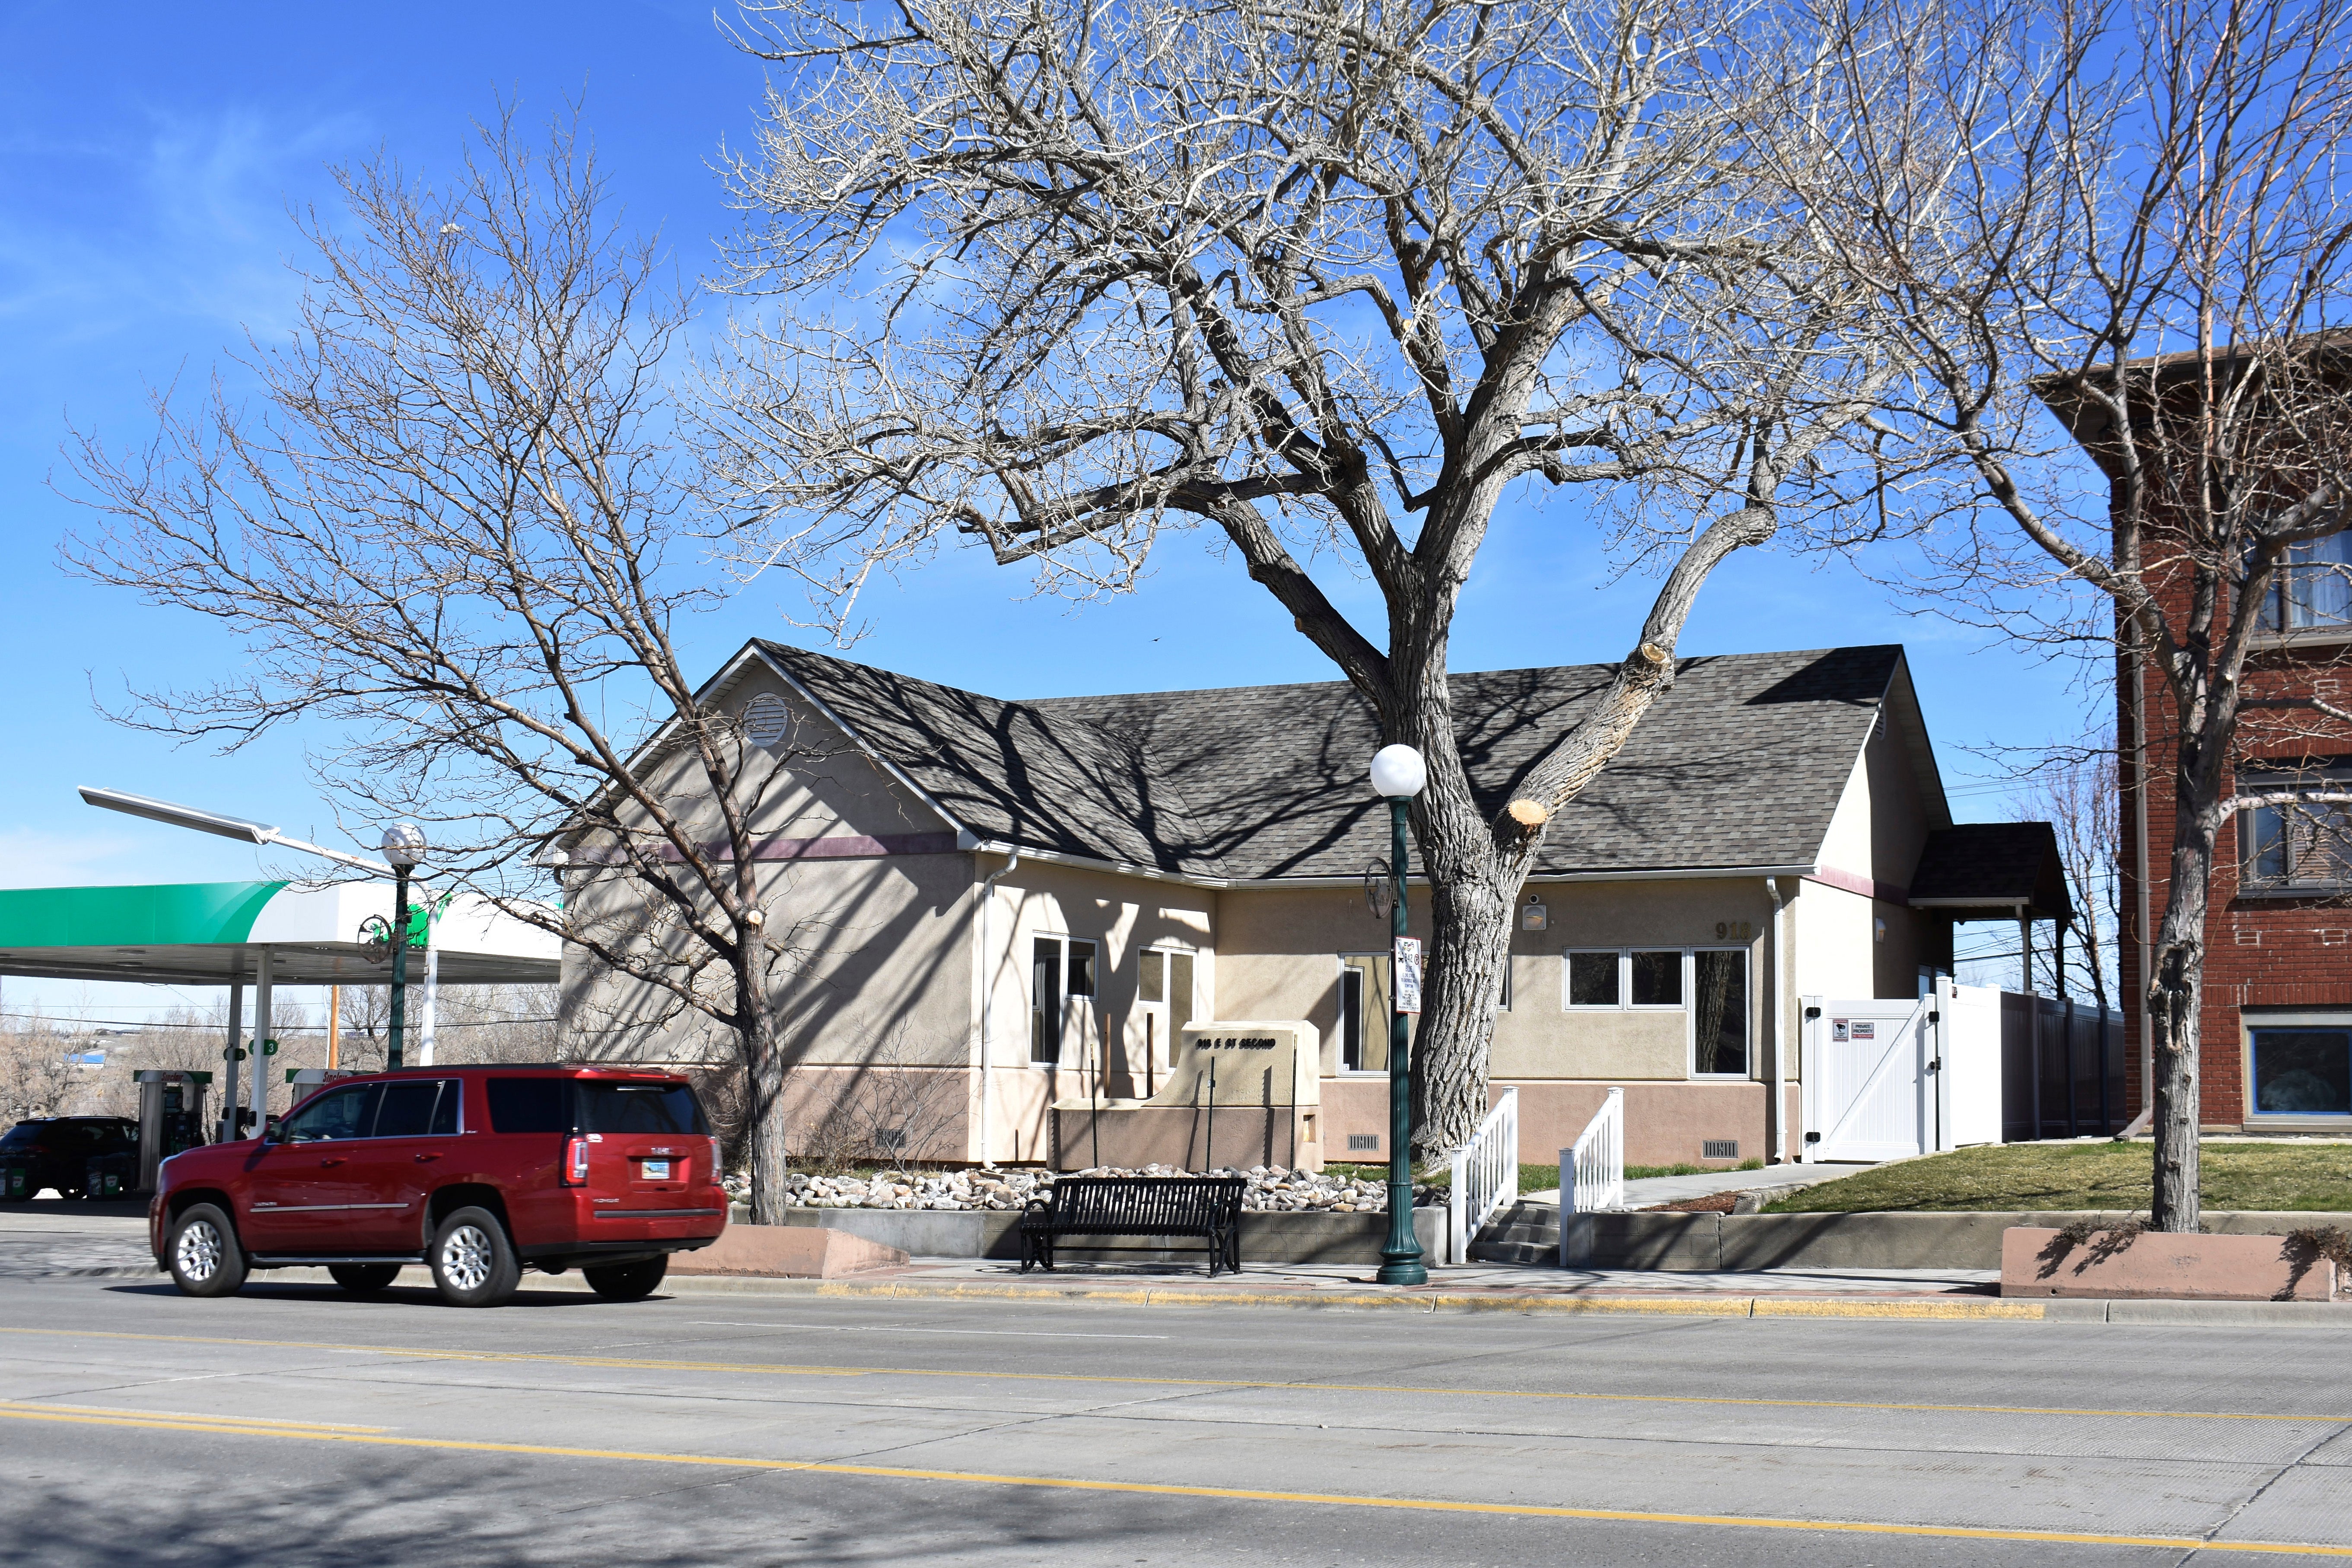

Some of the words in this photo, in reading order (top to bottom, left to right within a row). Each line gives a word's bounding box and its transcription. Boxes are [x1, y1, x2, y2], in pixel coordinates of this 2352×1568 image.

[1716, 922, 1752, 940] 918
[1197, 1038, 1212, 1047] 918
[1216, 1038, 1221, 1047] E
[1225, 1038, 1237, 1047] ST
[1240, 1038, 1276, 1047] SECOND
[268, 1043, 274, 1053] 3
[161, 1072, 184, 1081] Sinclair
